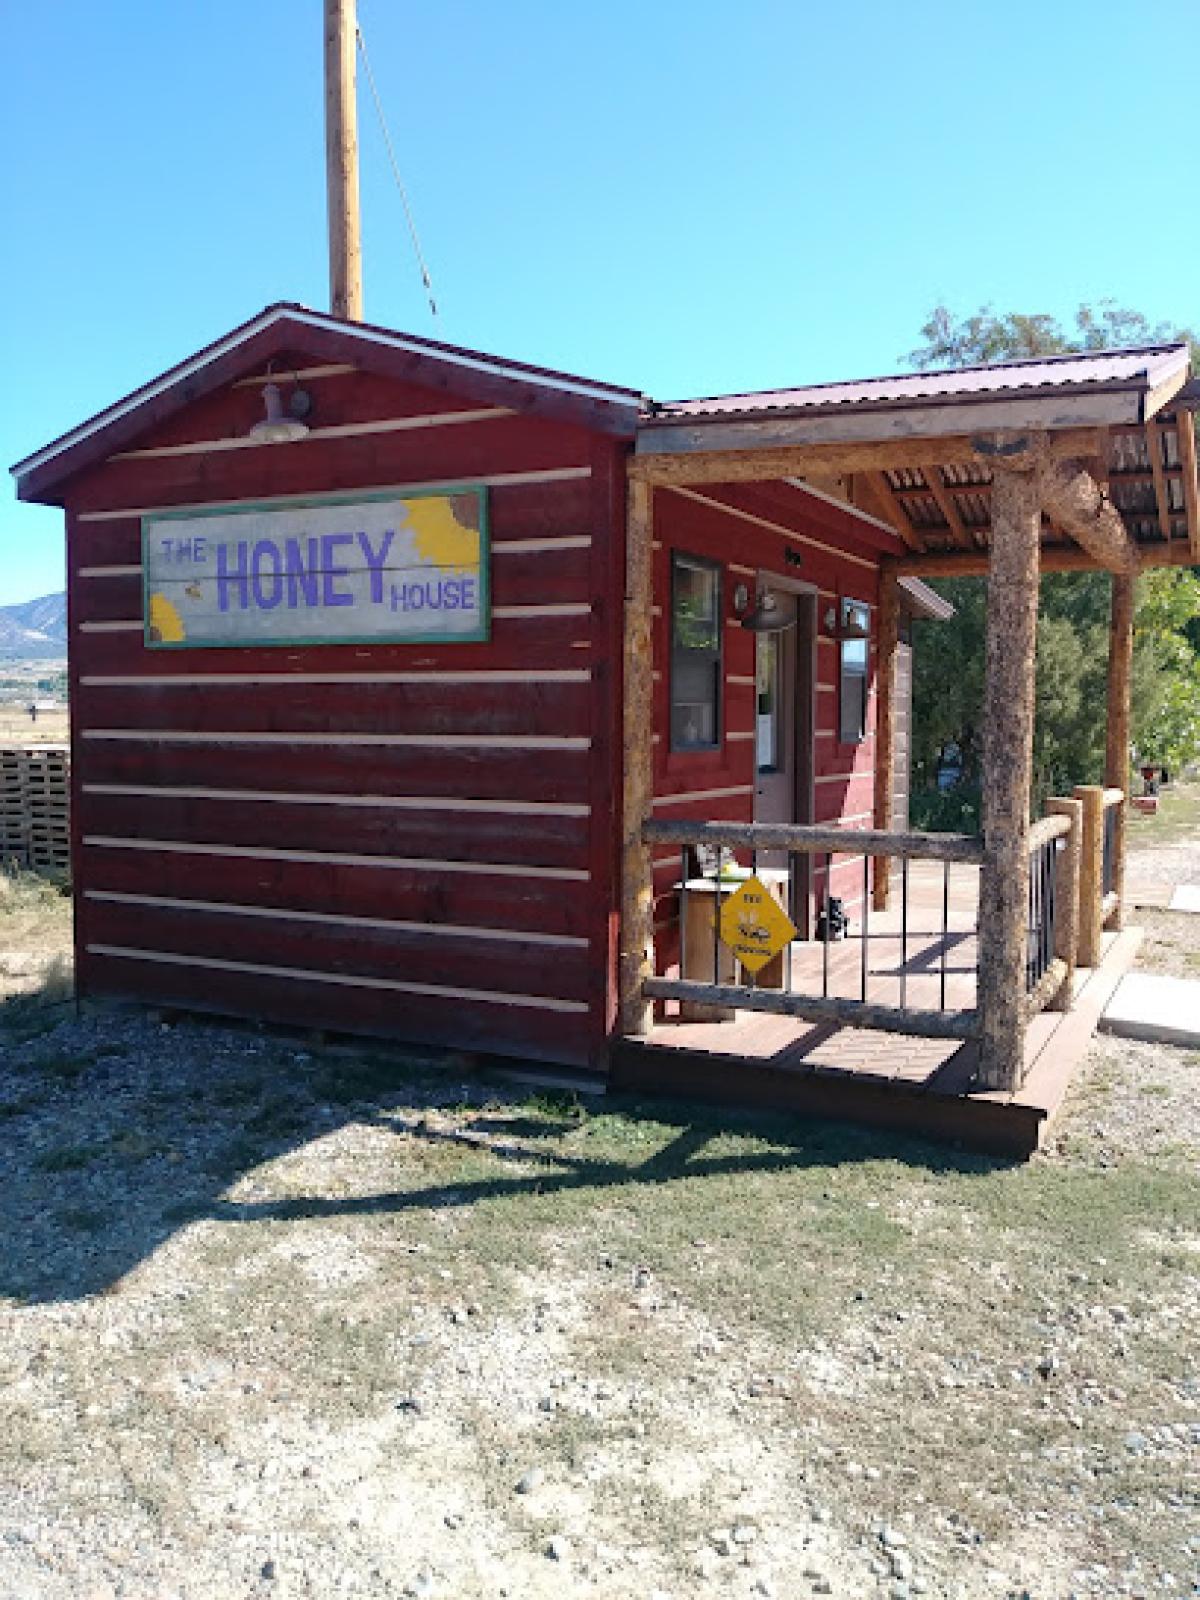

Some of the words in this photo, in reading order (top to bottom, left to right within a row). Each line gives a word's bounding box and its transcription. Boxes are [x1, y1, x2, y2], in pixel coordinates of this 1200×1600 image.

[161, 538, 206, 564] THE
[216, 530, 395, 612] HONEY
[390, 579, 475, 612] HOUSE
